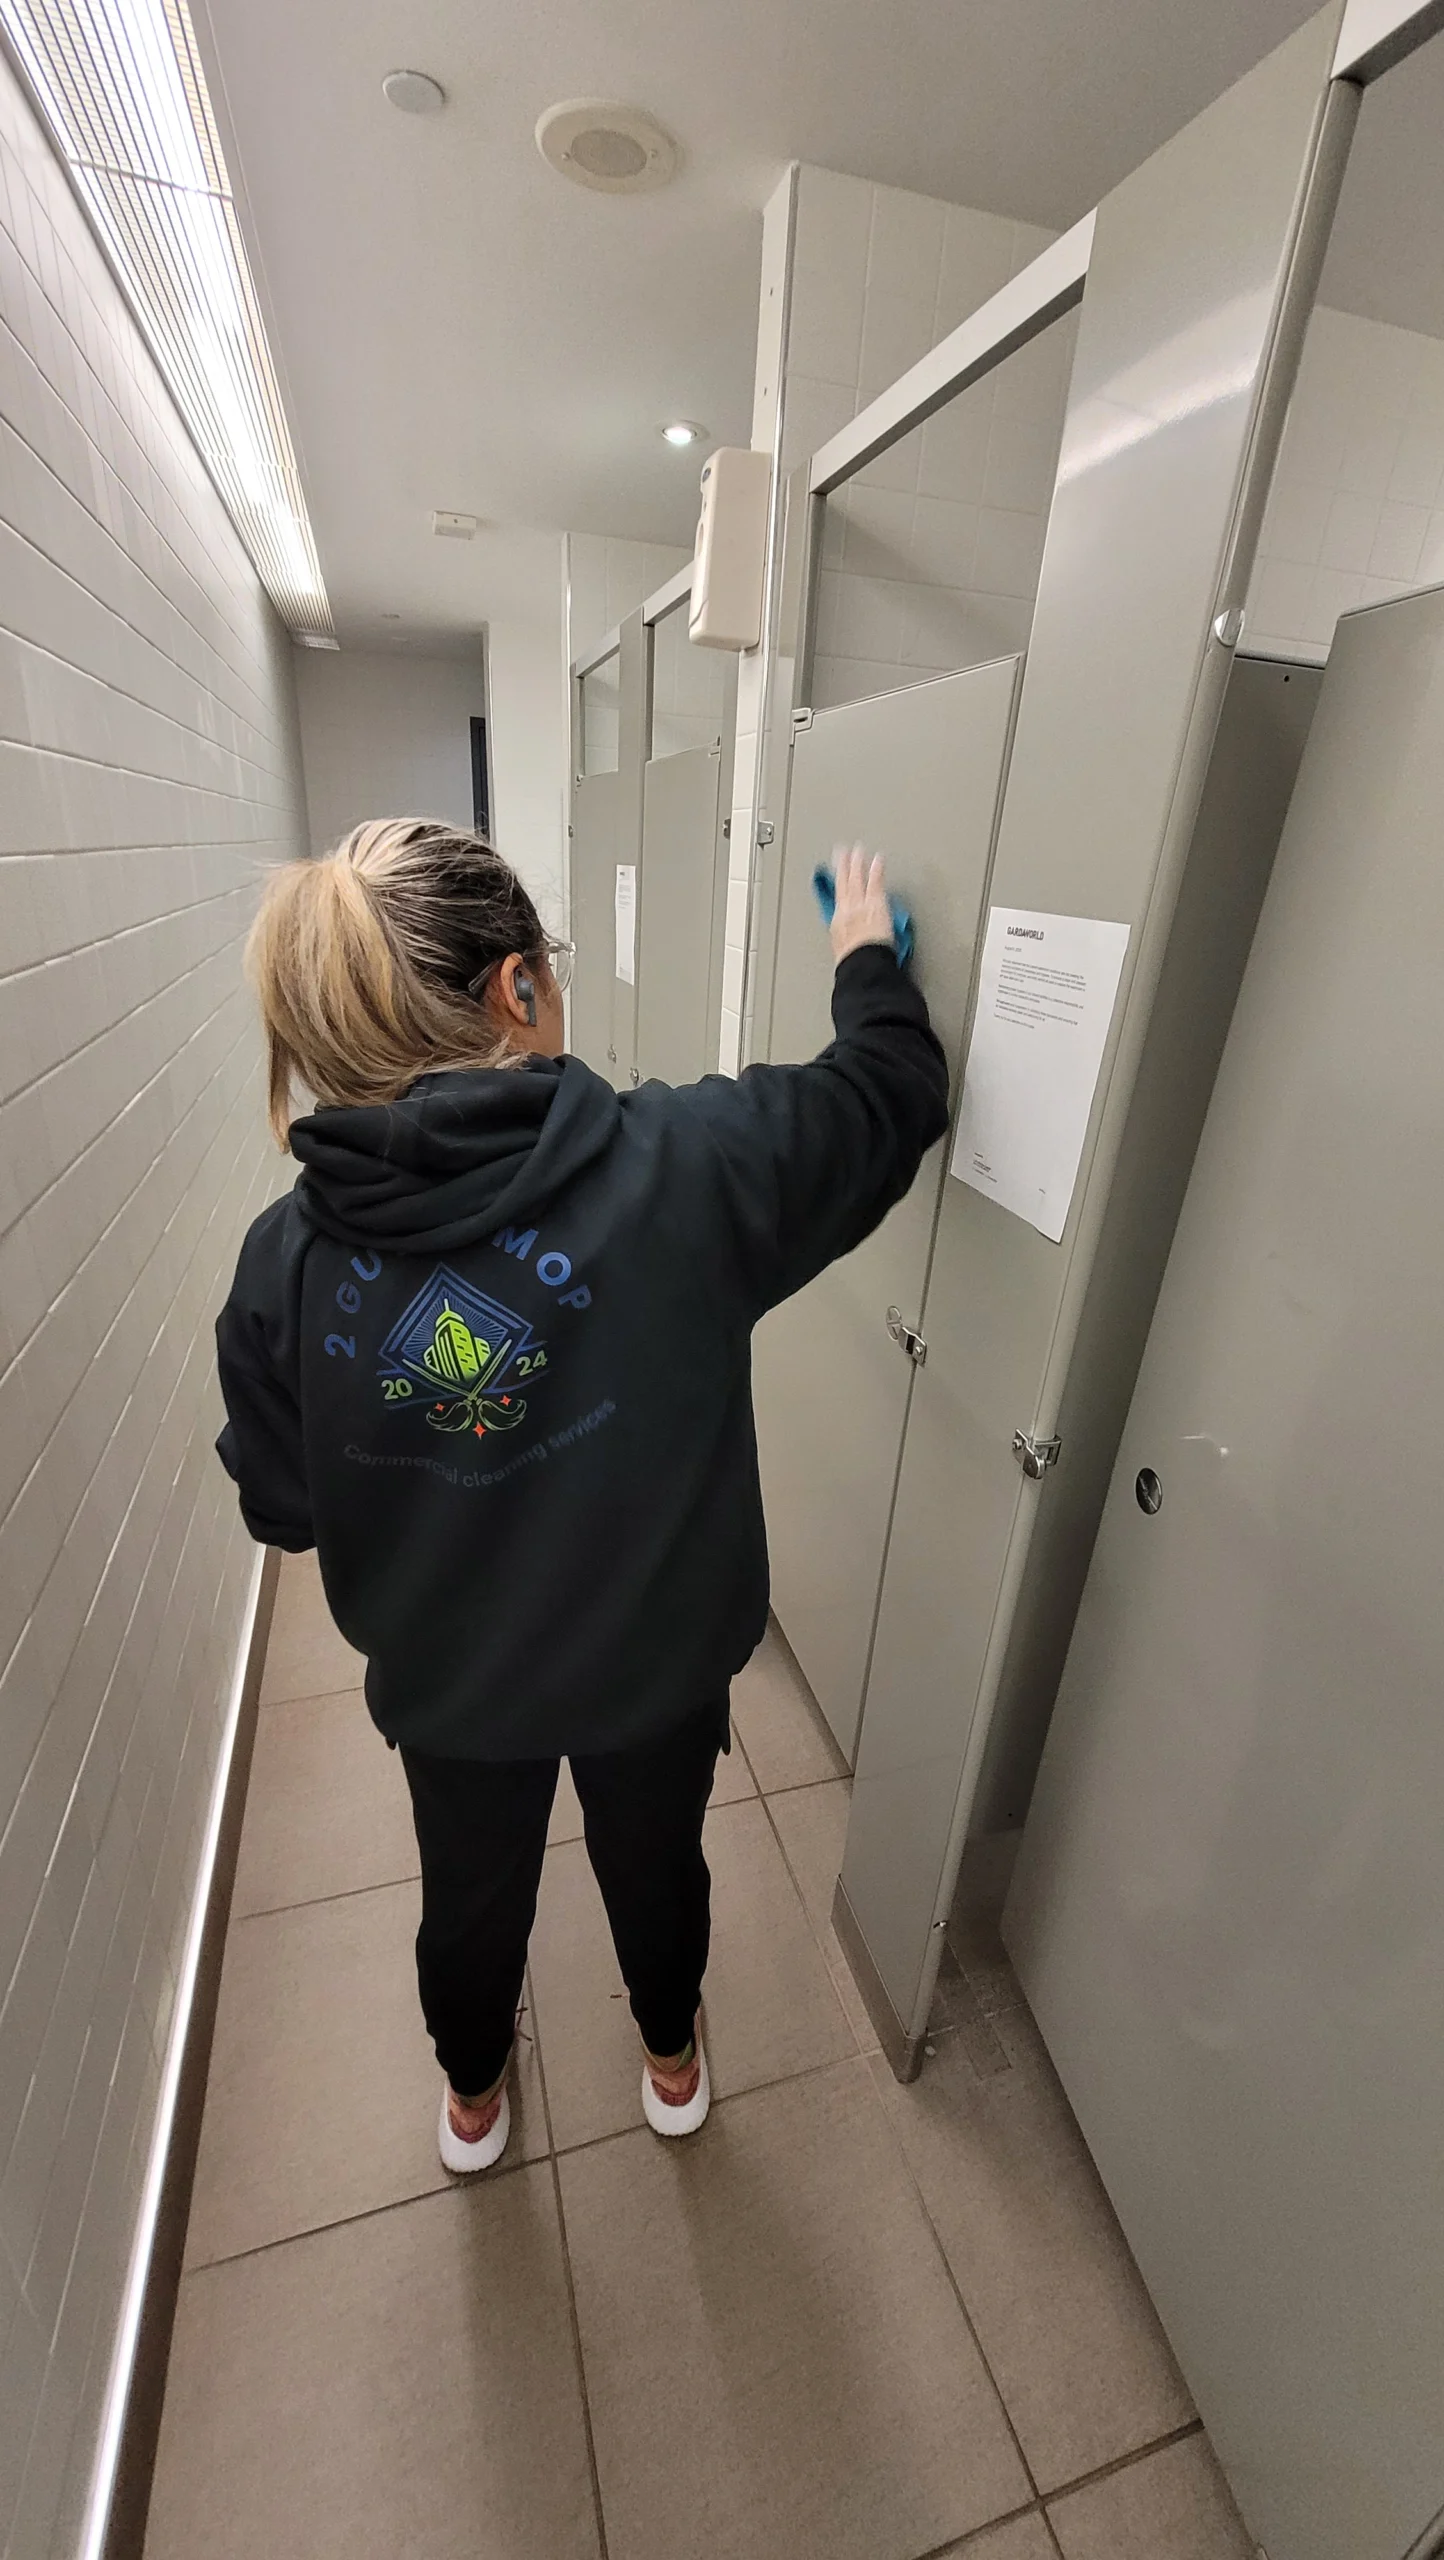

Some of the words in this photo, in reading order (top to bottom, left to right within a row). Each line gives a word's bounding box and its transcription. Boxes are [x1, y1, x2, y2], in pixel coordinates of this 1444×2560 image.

[324, 1333, 355, 1358] 2
[491, 1226, 593, 1310] MOP
[381, 1378, 413, 1401] 20
[516, 1350, 548, 1376] 24
[344, 1444, 458, 1485] Commercial
[462, 1441, 548, 1488] cleaning
[548, 1398, 616, 1450] services
